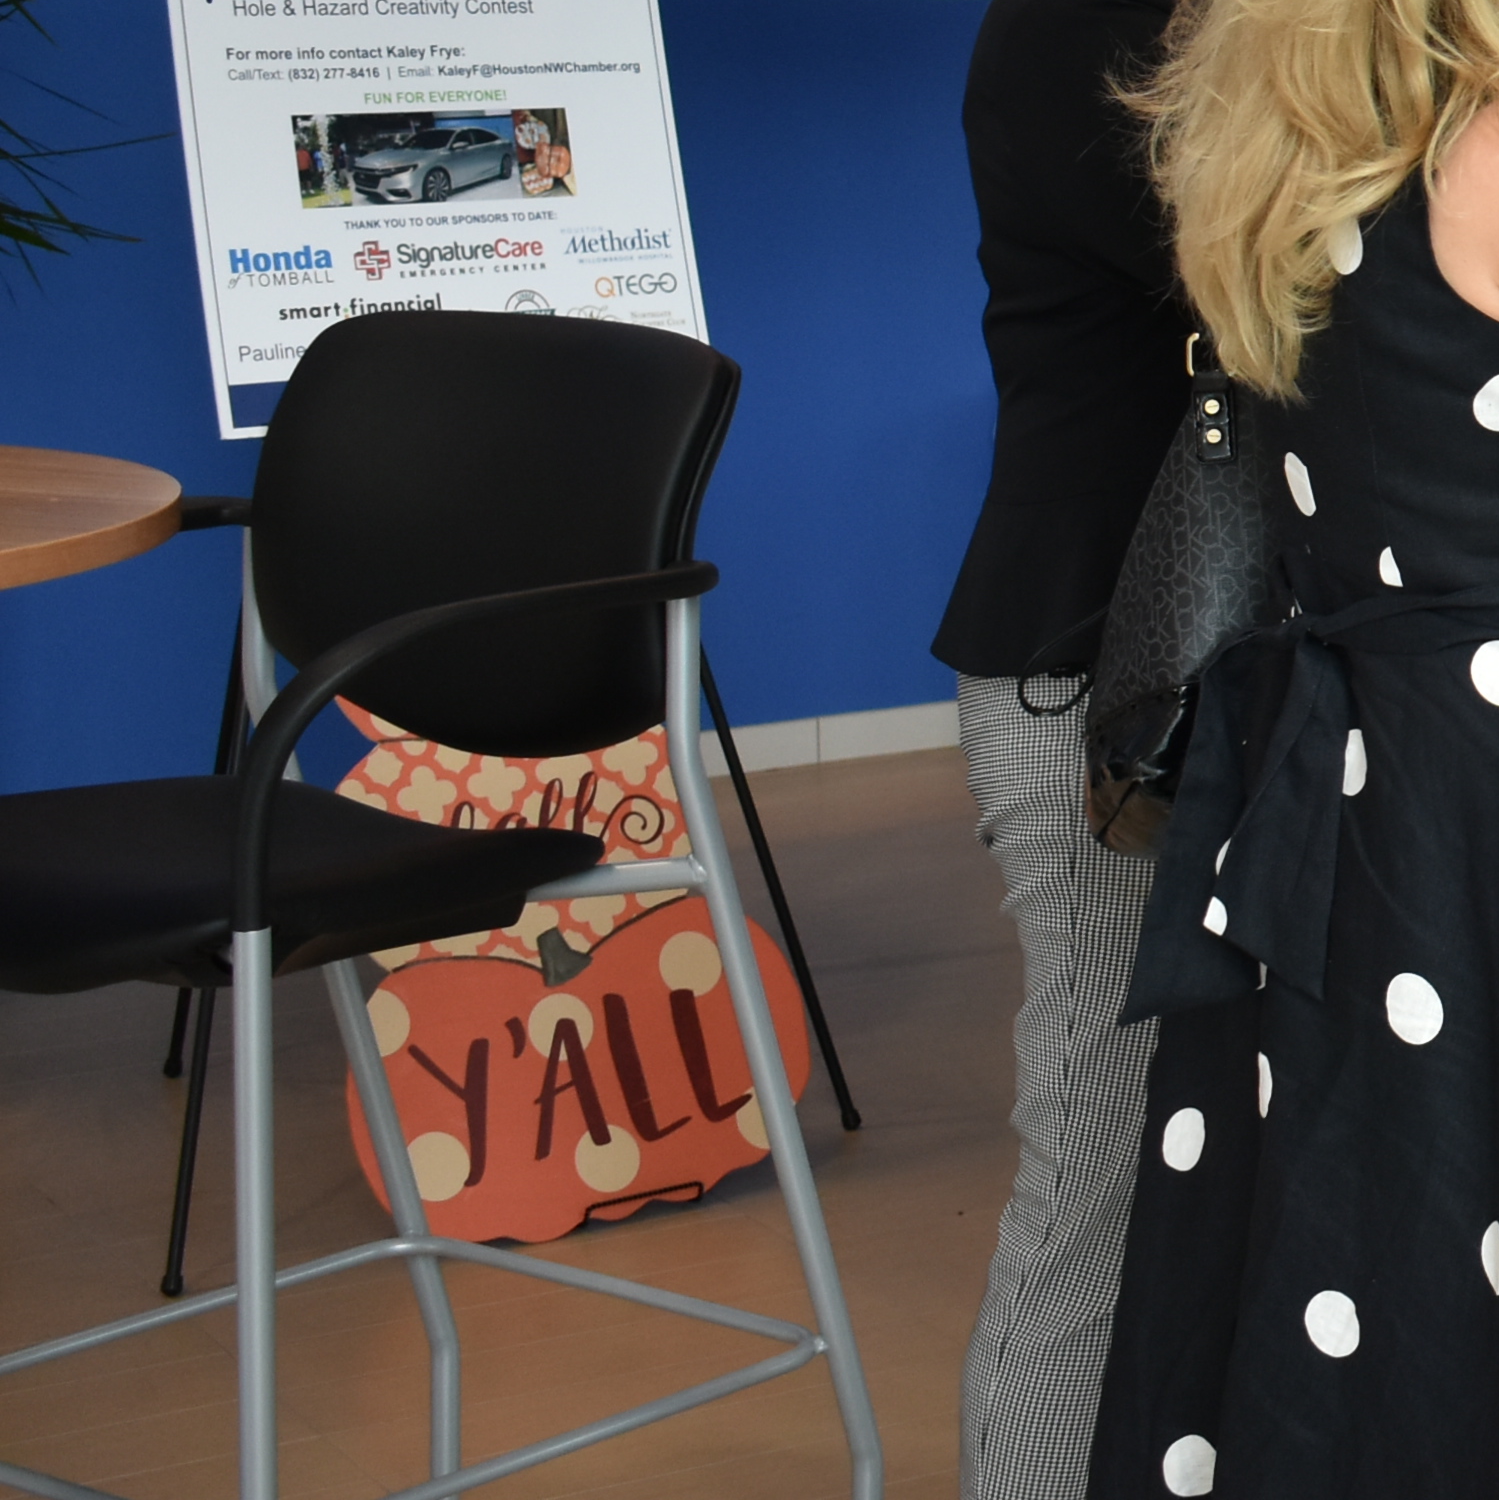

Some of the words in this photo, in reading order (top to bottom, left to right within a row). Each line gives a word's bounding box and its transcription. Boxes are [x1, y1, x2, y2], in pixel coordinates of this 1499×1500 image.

[232, 0, 276, 17] Hole
[226, 48, 250, 60] For
[255, 49, 293, 60] more
[297, 47, 325, 60] info
[329, 46, 382, 59] contact
[386, 46, 425, 61] Kaley
[430, 45, 466, 60] Frye:
[227, 68, 285, 81] Call/Text:
[288, 68, 320, 83] (832)
[323, 67, 380, 80] 277-8416
[398, 66, 434, 78] Email:
[438, 62, 641, 78] KaleyF@HoustonNWChamber.org
[364, 93, 392, 104] FUN
[396, 92, 425, 103] FOR
[429, 90, 507, 103] EVERYONE!
[344, 218, 381, 230] THANK
[383, 217, 406, 228] YOU
[408, 217, 424, 227] TO
[425, 216, 449, 226] OUR
[451, 212, 509, 225] SPONSORS
[511, 212, 526, 222] TO
[528, 211, 558, 221] DATE:
[563, 228, 672, 255] Methodist
[228, 245, 333, 273] Honda
[397, 238, 543, 269] SignatureCare
[246, 270, 335, 287] TOMBALL
[400, 266, 484, 278] EMERGENCY
[494, 263, 547, 273] CENTER
[594, 272, 678, 298] QTEGO
[407, 989, 752, 1188] Y'ALL
